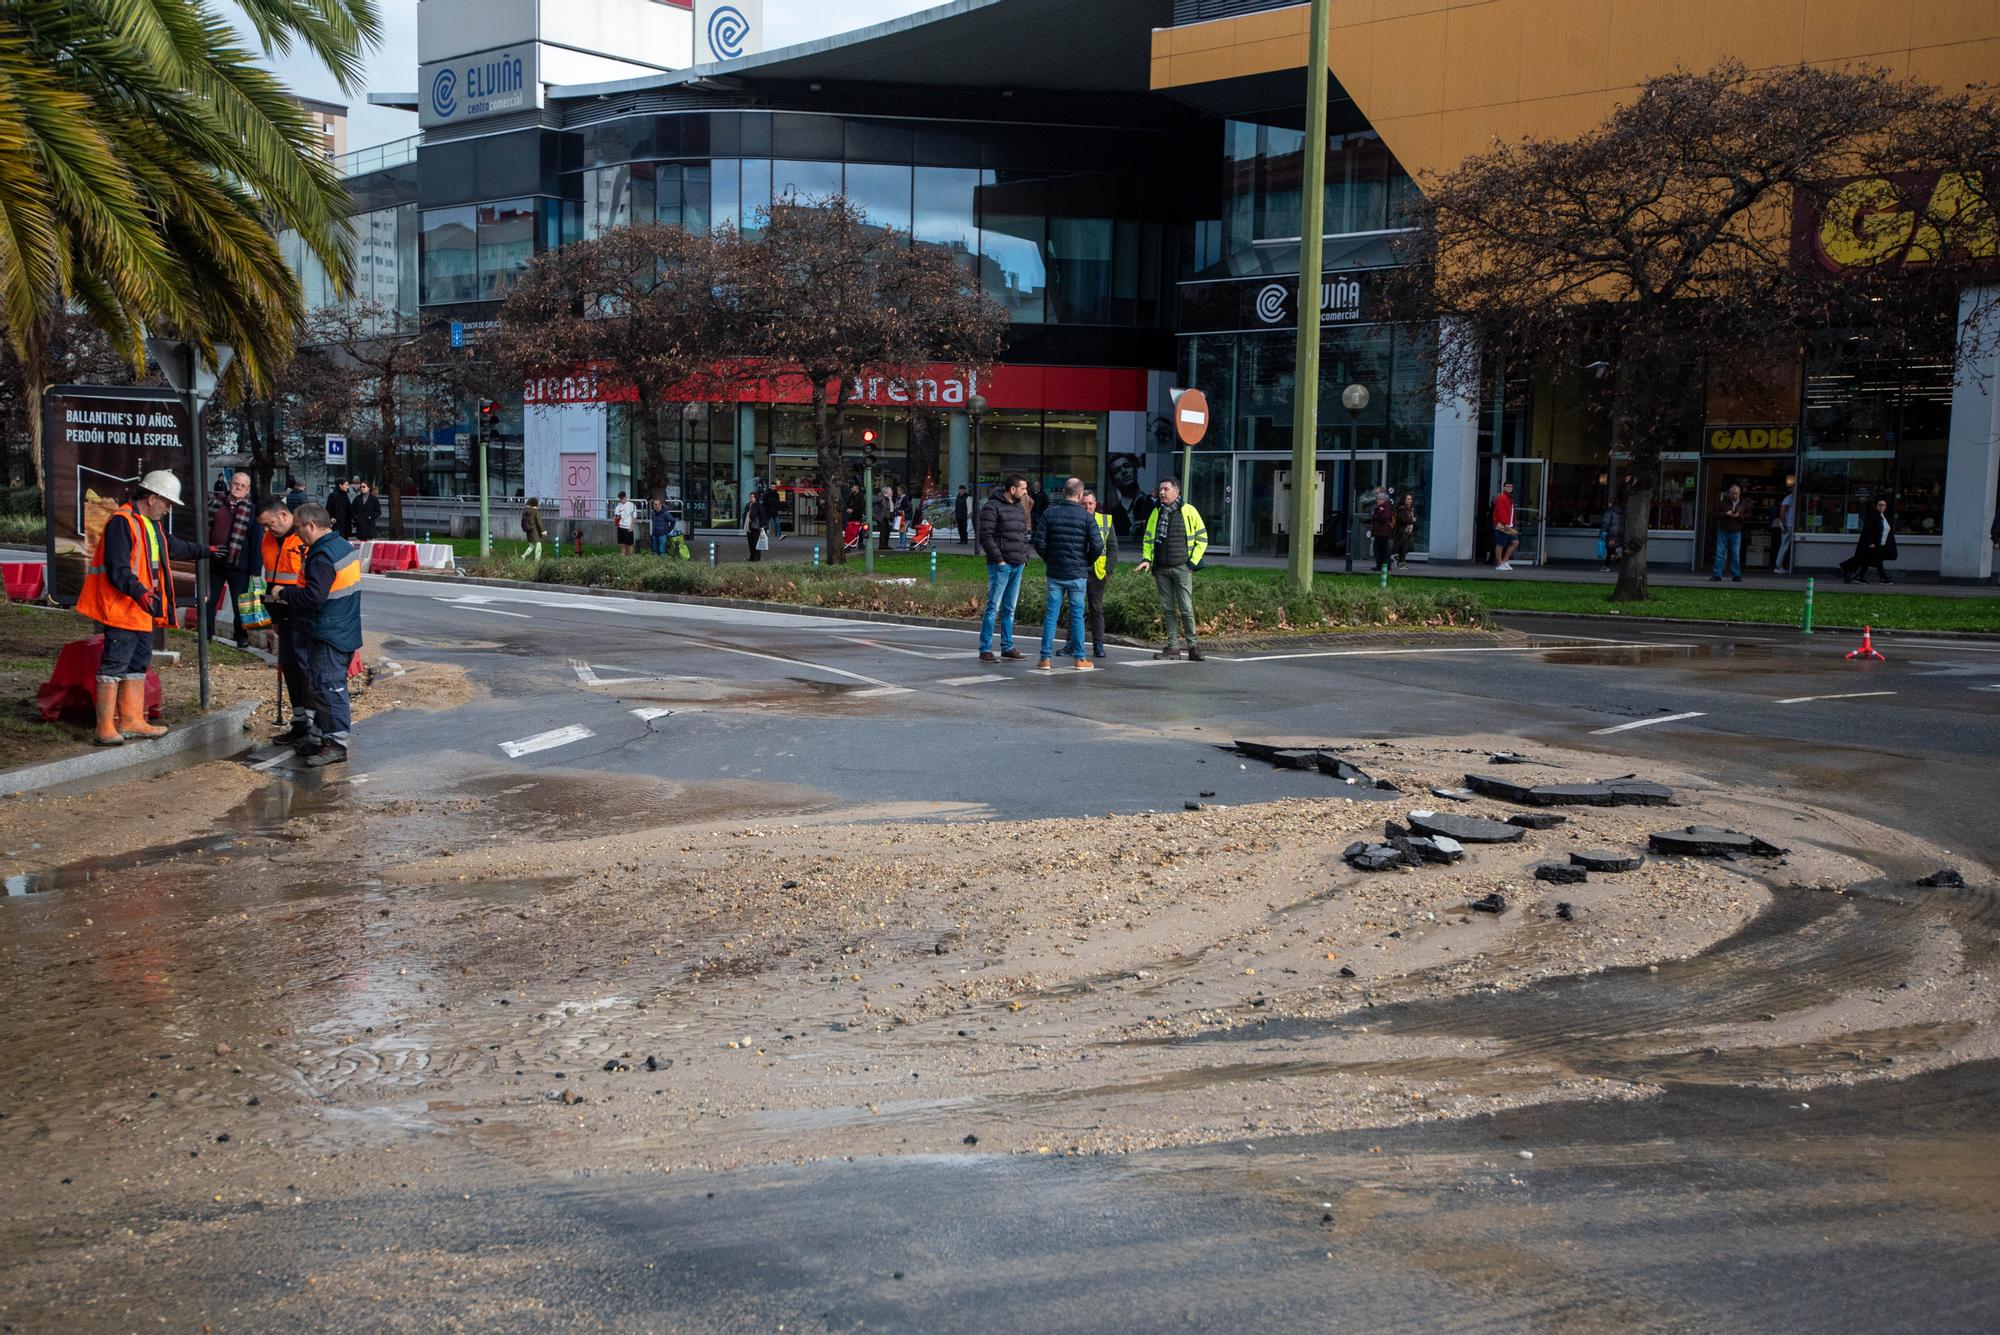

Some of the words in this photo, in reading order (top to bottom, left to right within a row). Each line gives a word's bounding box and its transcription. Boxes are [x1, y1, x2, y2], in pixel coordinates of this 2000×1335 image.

[467, 53, 522, 98] ELVIÑA
[66, 409, 133, 426] BALLANTINE'S
[135, 413, 146, 427] 10
[148, 412, 177, 428] AÑOS.
[66, 427, 105, 443] PERDÓN
[107, 431, 127, 445] POR
[129, 432, 141, 445] LA
[143, 433, 183, 447] ESPERA.
[1711, 428, 1794, 450] GADIS
